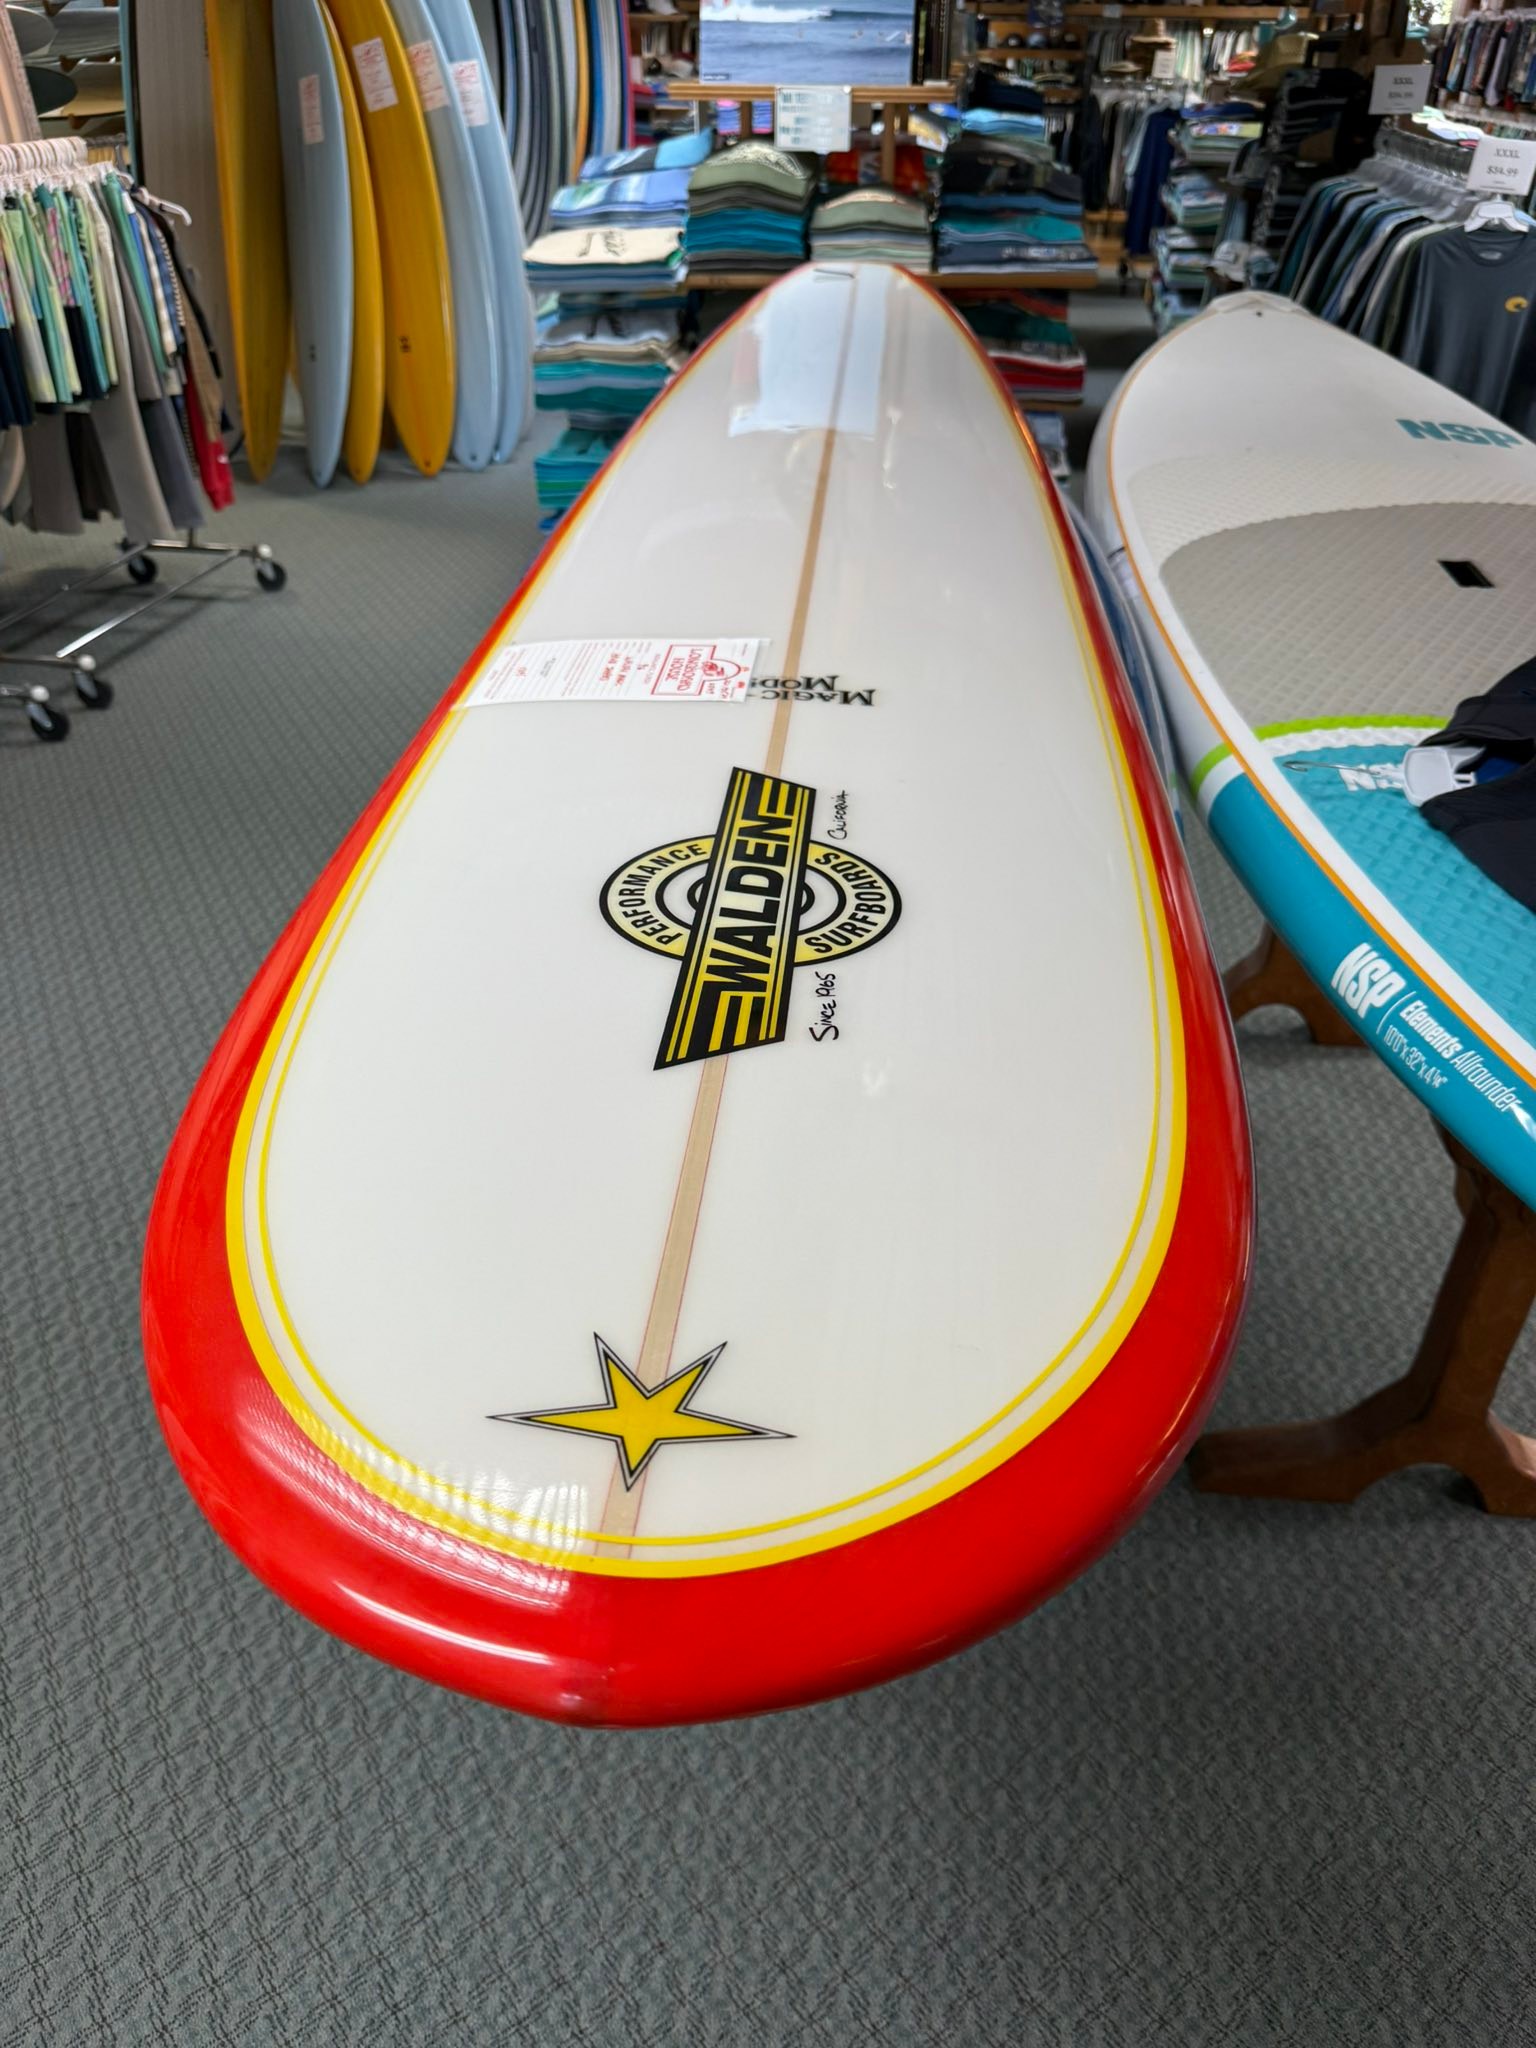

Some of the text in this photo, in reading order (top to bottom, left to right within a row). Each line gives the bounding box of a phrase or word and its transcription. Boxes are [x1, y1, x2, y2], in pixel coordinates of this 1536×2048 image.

[1395, 418, 1523, 449] NSP
[761, 689, 876, 706] MAGIC
[1333, 763, 1405, 792] NS
[618, 842, 708, 946] PERFORMANCE
[702, 814, 795, 995] WALDEN
[804, 852, 887, 954] SURFBOARDS
[815, 971, 837, 998] 1965
[1331, 942, 1407, 1019] NSP
[1399, 1000, 1523, 1112] Elements Allrounder
